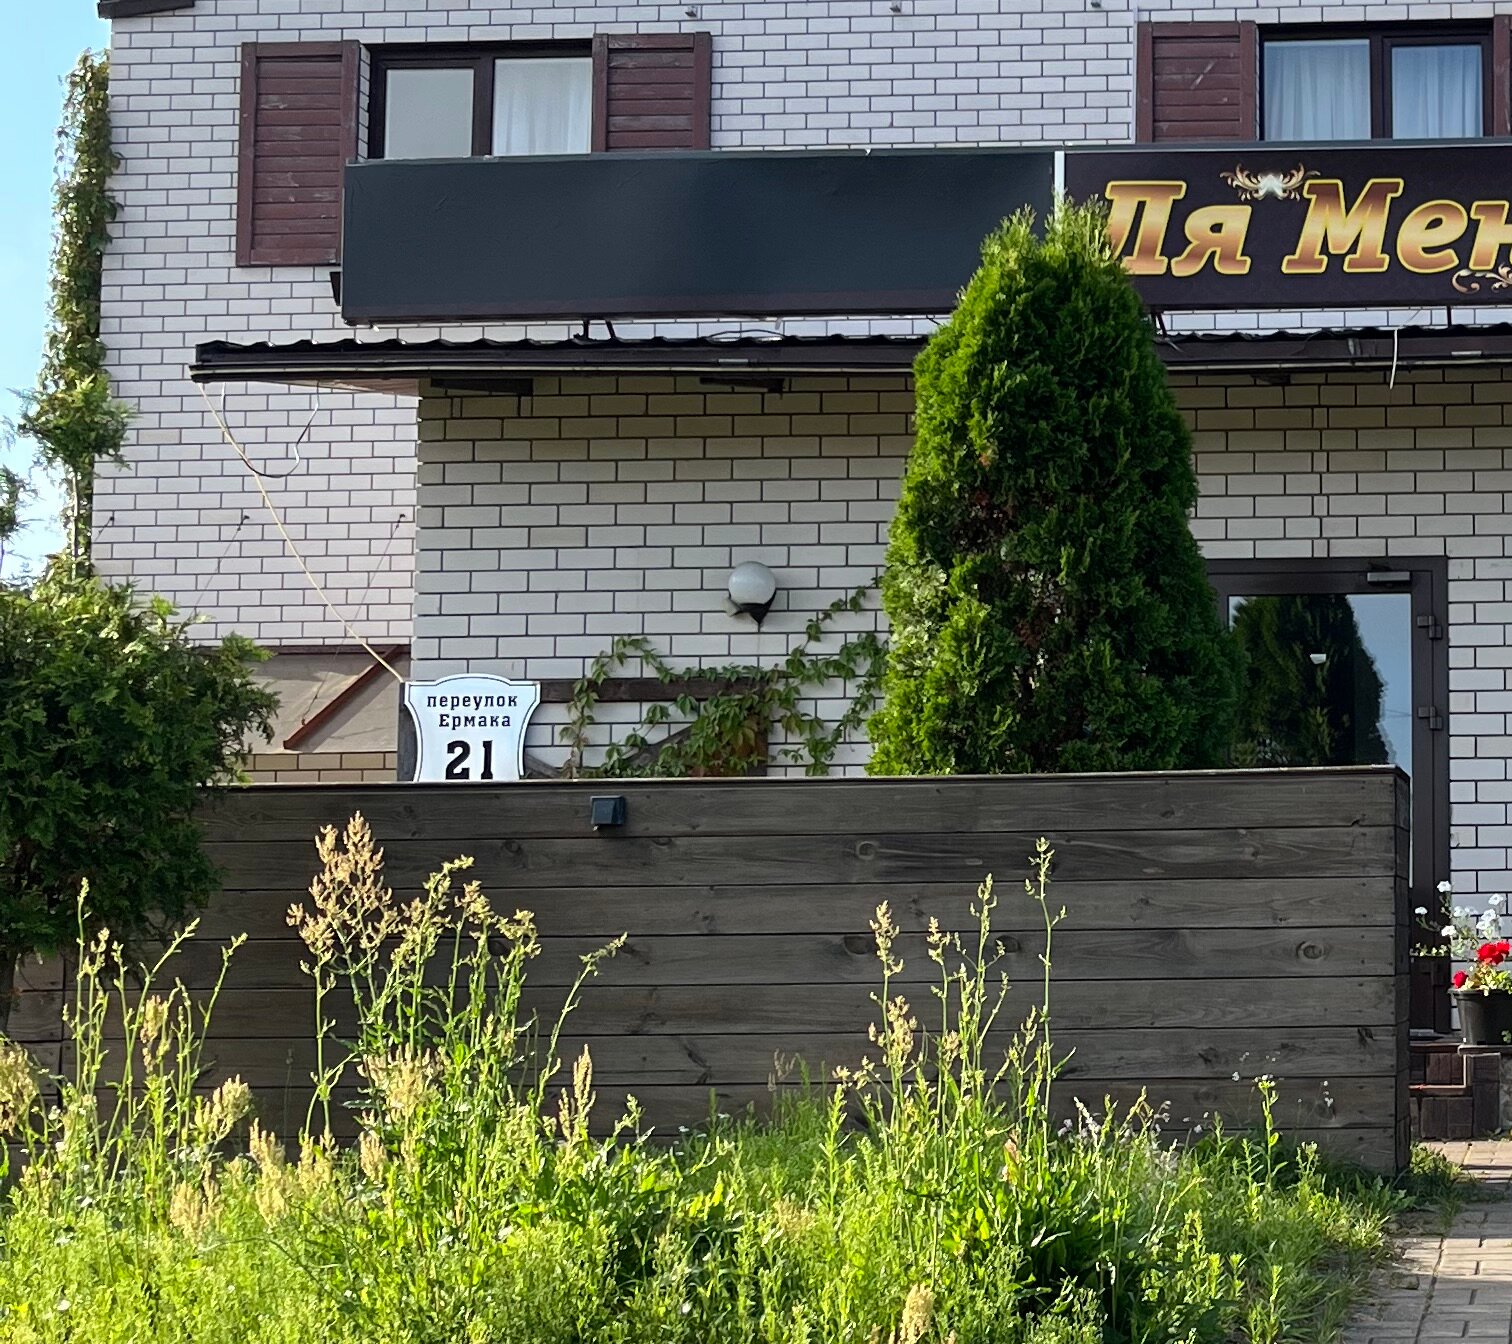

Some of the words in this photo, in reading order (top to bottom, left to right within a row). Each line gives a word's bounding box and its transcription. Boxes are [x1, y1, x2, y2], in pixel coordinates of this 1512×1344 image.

[1101, 180, 1252, 277] Ля
[427, 695, 518, 710] переулок
[439, 713, 511, 730] Ермака
[445, 740, 493, 780] 21
